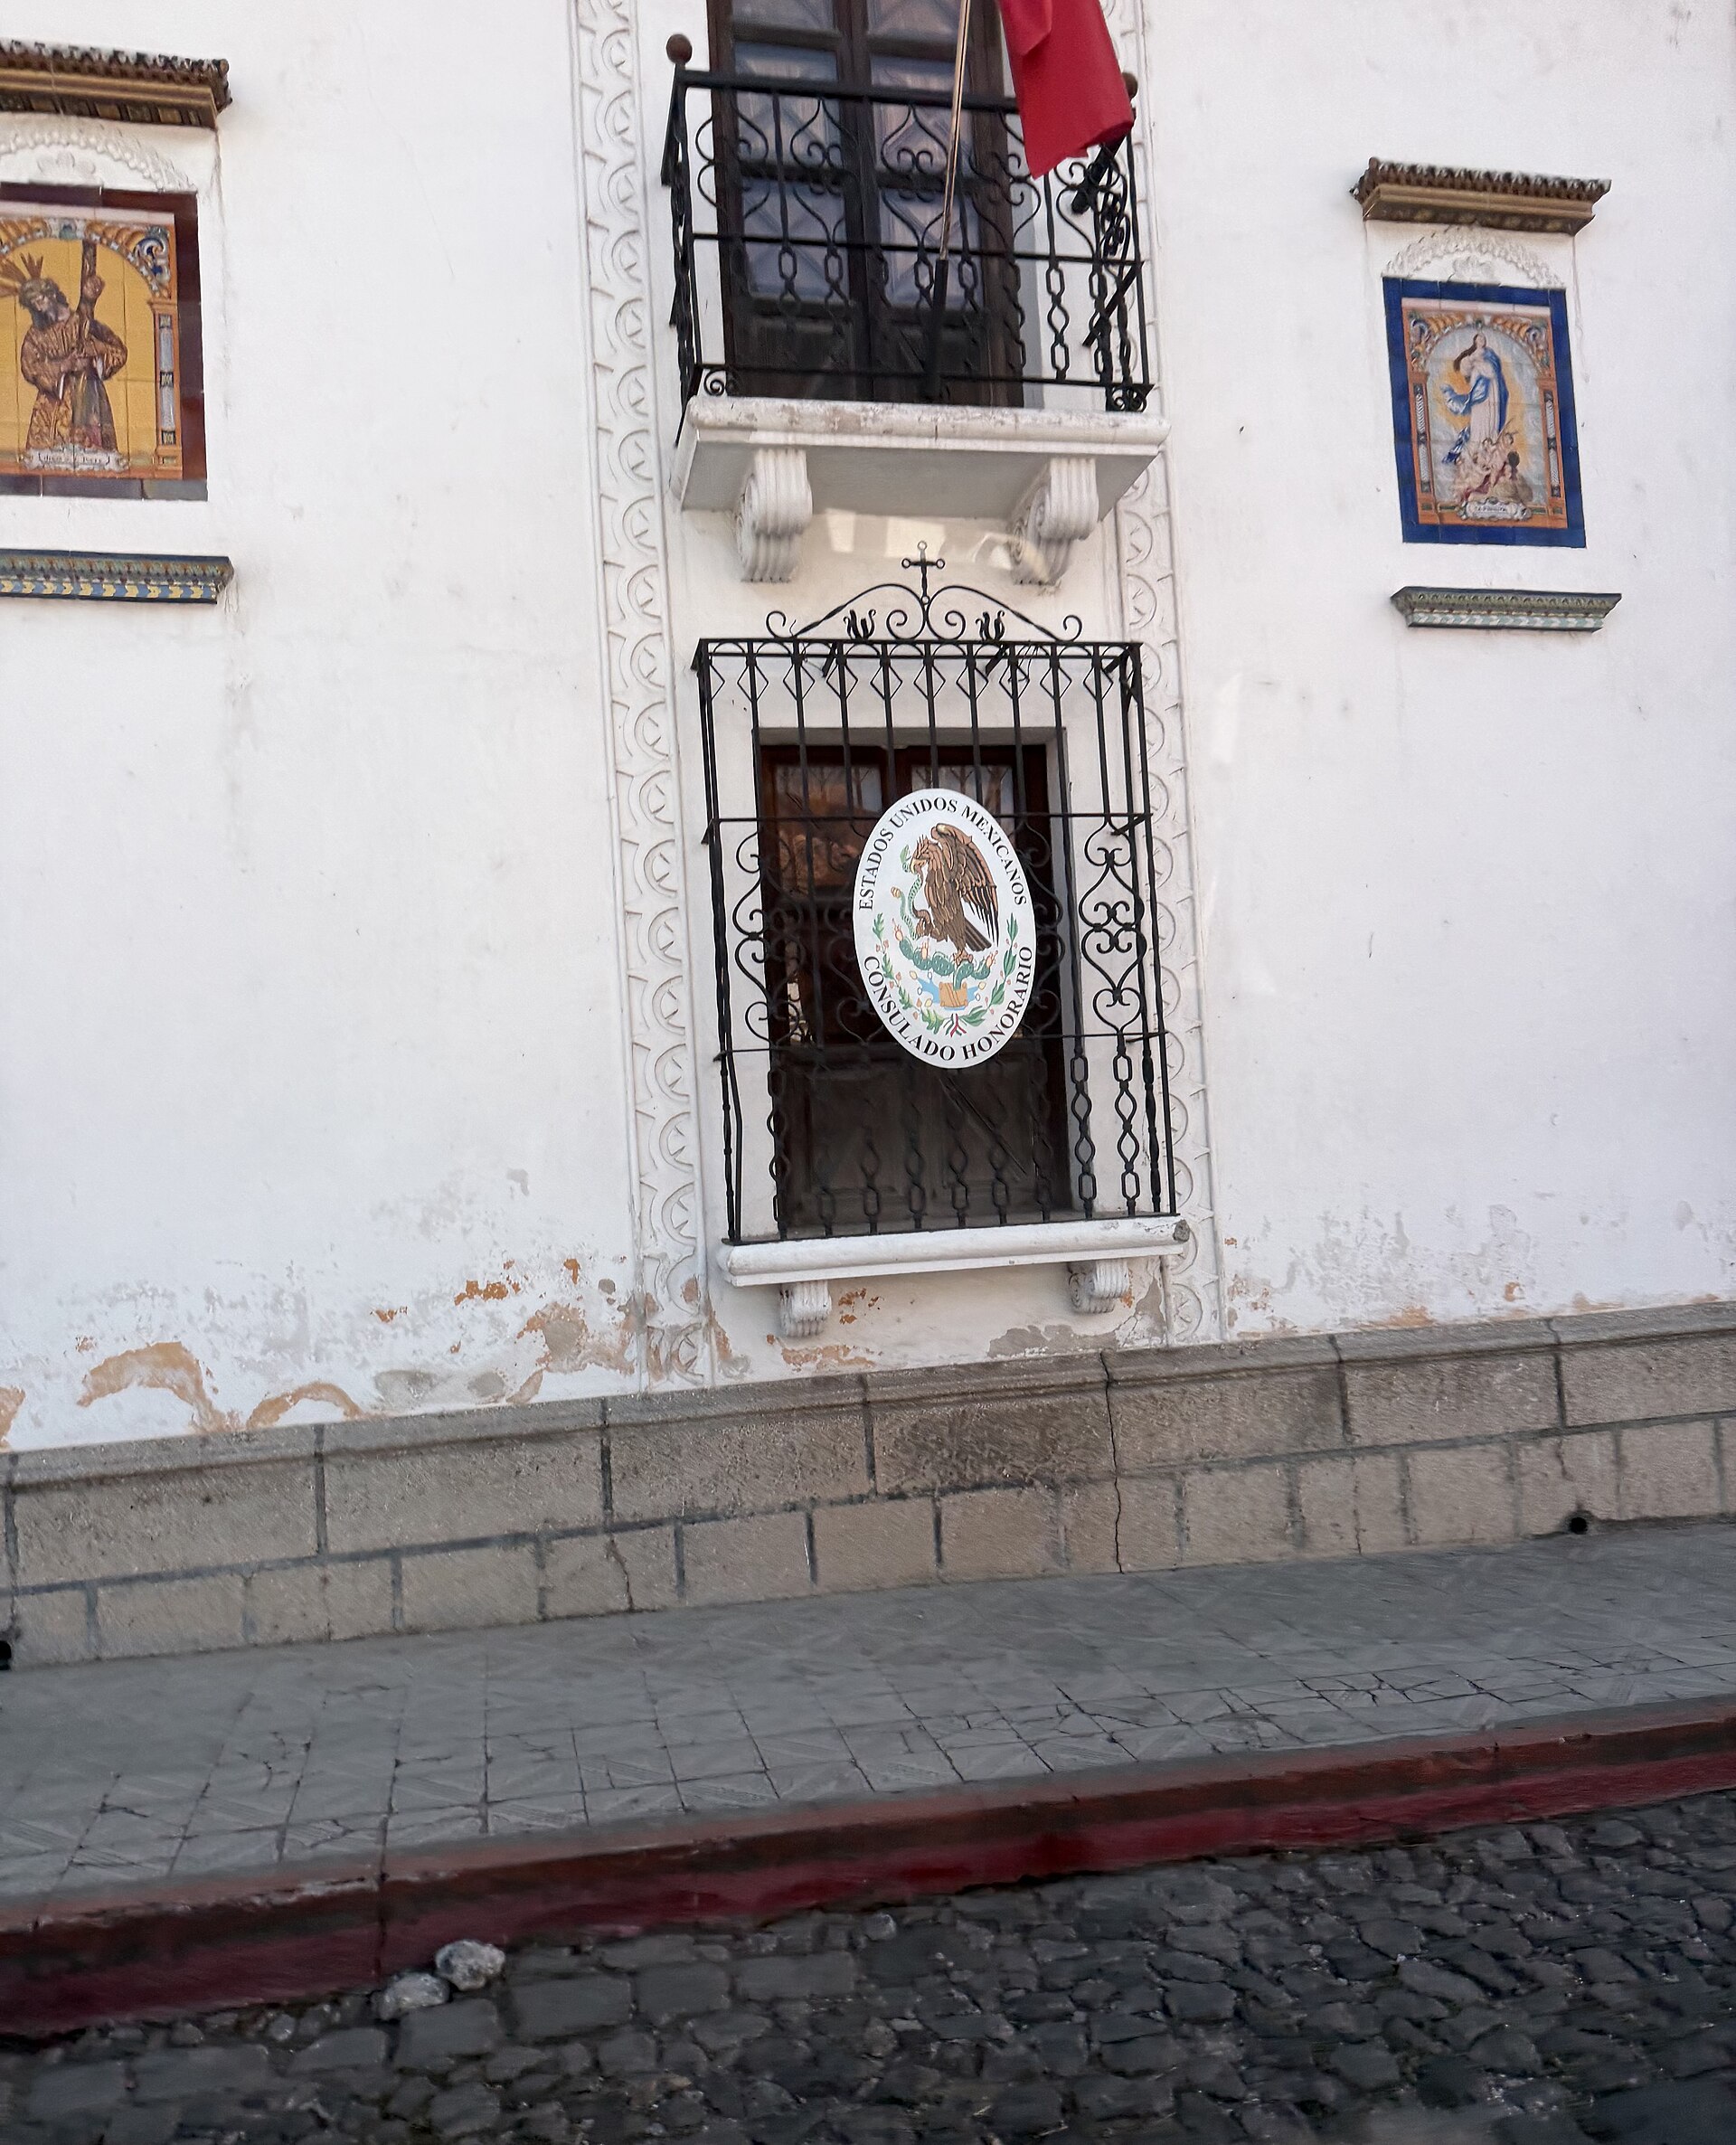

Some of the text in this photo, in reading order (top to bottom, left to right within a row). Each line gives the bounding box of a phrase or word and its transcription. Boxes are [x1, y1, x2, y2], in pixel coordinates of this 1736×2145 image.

[859, 797, 1028, 911] ESTADOS UNIDOS MEXICANOS
[863, 947, 1033, 1061] CONSULADO HONORARIO
